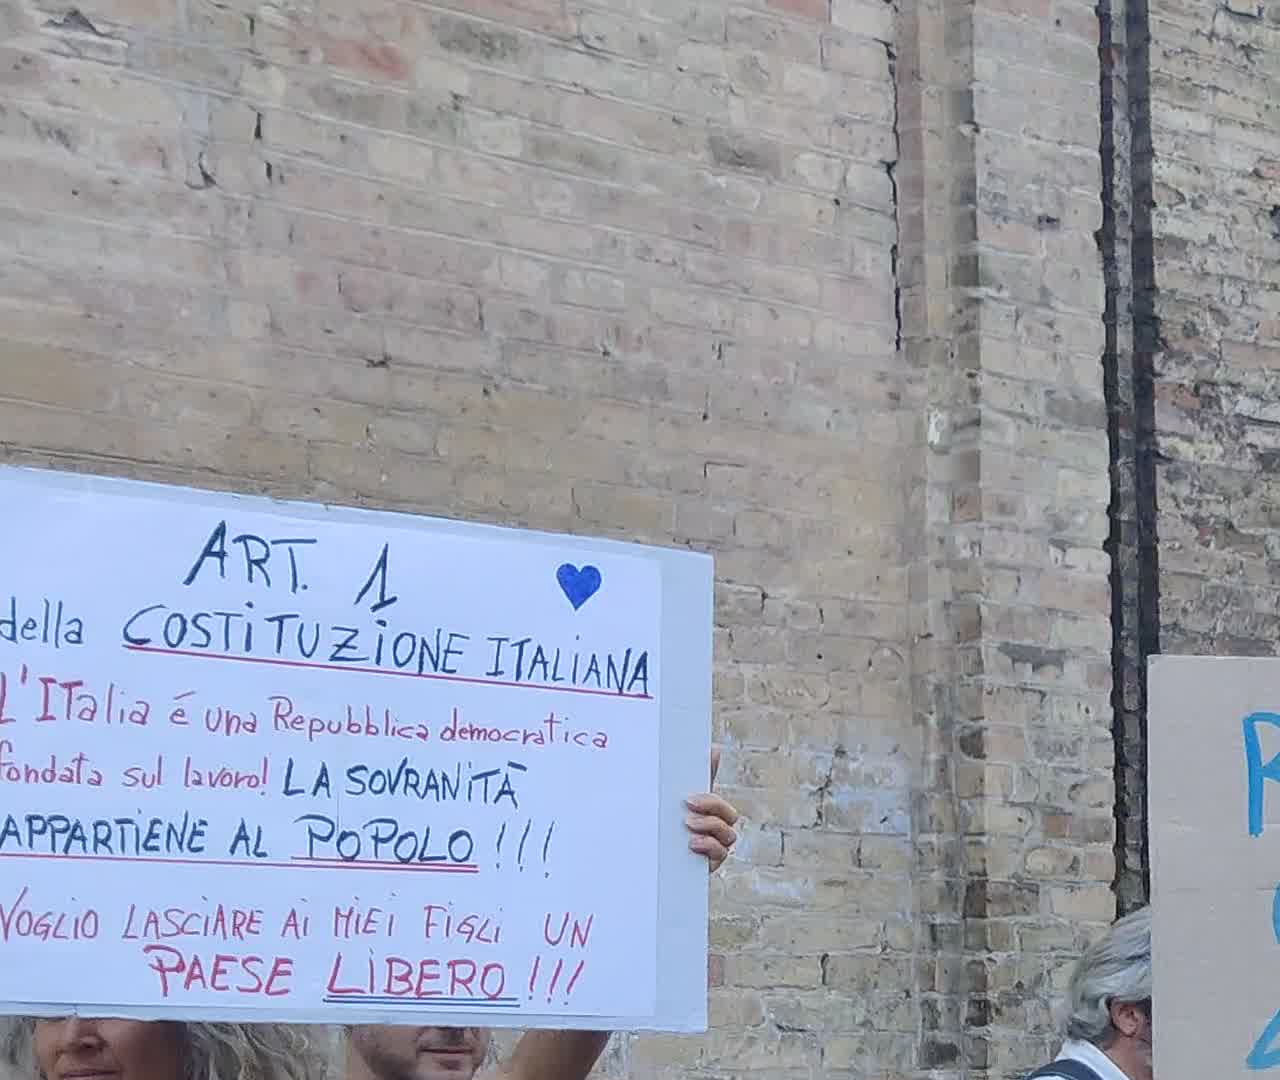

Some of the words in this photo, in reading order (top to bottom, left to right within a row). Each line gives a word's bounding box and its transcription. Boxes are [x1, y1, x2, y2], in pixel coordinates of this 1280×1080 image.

[183, 519, 317, 594] ART.
[354, 541, 398, 613] 1
[0, 596, 84, 648] della
[205, 706, 258, 738] una
[268, 696, 430, 742] Repubblica
[438, 706, 608, 750] democratica
[0, 738, 103, 788] fondata
[121, 755, 163, 788] sul
[183, 757, 270, 796] lavoro!
[282, 757, 332, 799] LA
[0, 808, 209, 856] APPARTIENE
[229, 817, 269, 858] AL
[294, 814, 476, 864] POPOLO
[0, 886, 99, 943] VOGLIO
[544, 911, 595, 949] UN
[143, 944, 294, 998] PAESE
